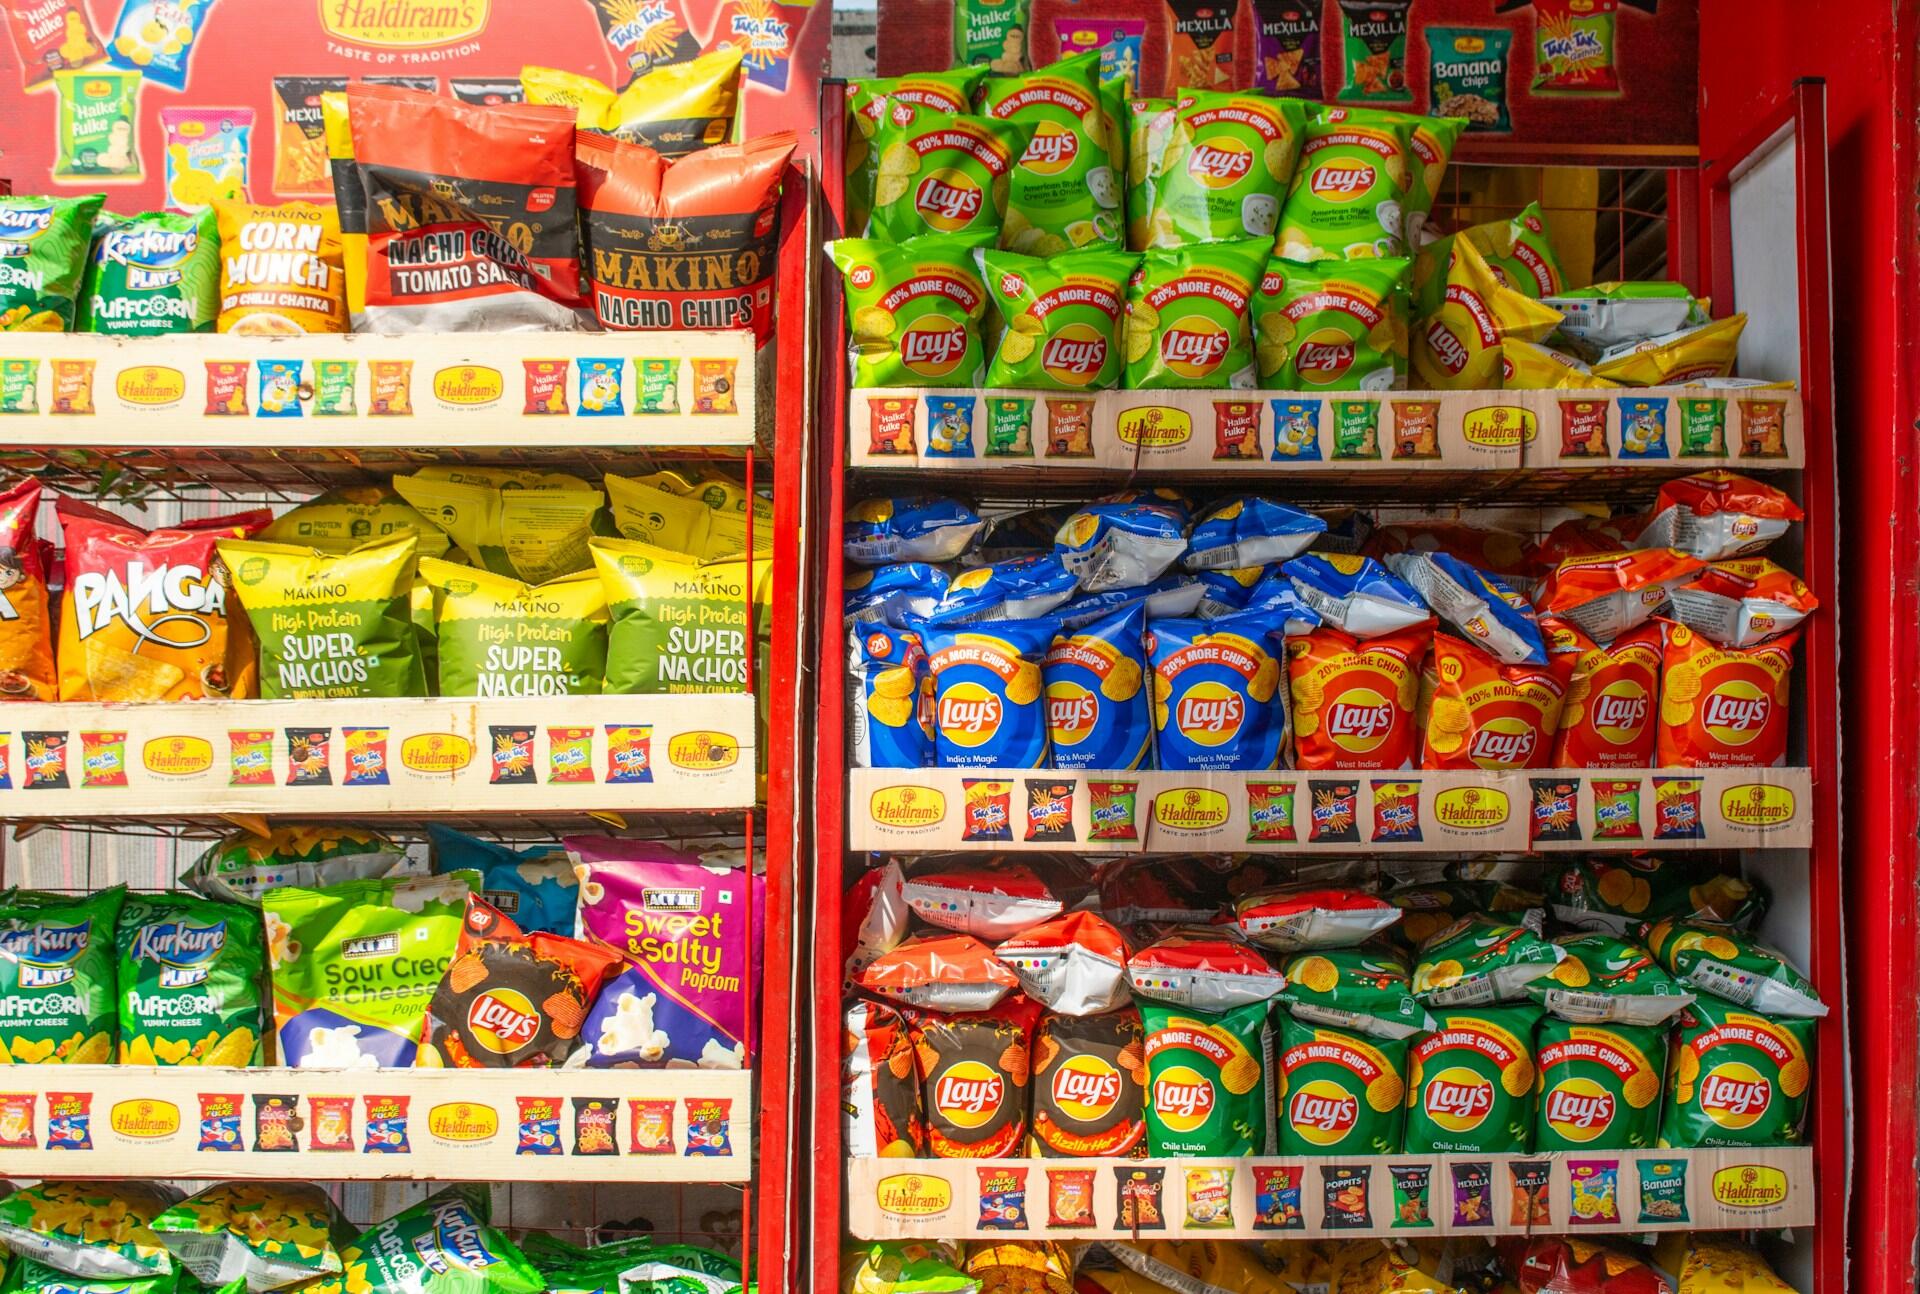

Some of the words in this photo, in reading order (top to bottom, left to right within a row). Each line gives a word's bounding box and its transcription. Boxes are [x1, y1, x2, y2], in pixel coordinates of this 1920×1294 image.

[25, 0, 66, 25] Halke
[334, 0, 476, 28] Haldiram's
[971, 5, 1011, 27] Halke
[27, 14, 64, 44] Fulke
[733, 16, 760, 32] TAKA
[764, 18, 789, 38] TAK
[966, 25, 1002, 43] Fulke
[1177, 19, 1233, 33] MEXILLA
[1263, 22, 1319, 35] MEXILLA
[1349, 21, 1405, 37] MEXILLA
[327, 42, 371, 62] TASTE
[377, 53, 396, 64] OF
[402, 42, 481, 64] TRADITION
[1543, 39, 1572, 59] TAKA
[1573, 31, 1598, 48] TAK
[1435, 60, 1502, 78] Banana
[75, 100, 117, 119] Halke
[72, 120, 109, 136] Fulke
[916, 137, 942, 153] 20%
[944, 134, 974, 149] MORE
[975, 142, 1002, 171] CHIPS
[1312, 166, 1374, 195] Lay's
[917, 178, 980, 219] Lay's
[250, 210, 323, 221] MAKINO
[101, 226, 198, 265] Kurkure
[240, 222, 322, 252] CORN
[388, 231, 465, 267] NACHO
[130, 270, 181, 288] PLAYZ
[226, 255, 328, 290] MUNCH
[397, 264, 472, 294] TOMATO
[593, 248, 761, 290] MAKINO
[240, 293, 277, 308] CHILLI
[279, 293, 329, 312] CHATKA
[885, 289, 909, 310] 20%
[909, 280, 943, 294] MORE
[944, 281, 976, 307] CHIPS
[91, 295, 198, 320] PUFFCORN
[598, 293, 672, 327] NACHO
[682, 295, 754, 328] CHIPS
[107, 320, 139, 329] YUMMY
[140, 320, 173, 329] CHEESE
[121, 378, 179, 398] Haldiram's
[439, 378, 497, 397] Haldiram's
[878, 421, 901, 432] Fulke
[881, 412, 906, 423] Halke
[993, 423, 1016, 433] Fulke
[997, 413, 1022, 423] Halke
[283, 584, 348, 601] MAKINO
[673, 581, 742, 597] MAKINO
[74, 561, 227, 647] PANGA
[493, 601, 560, 614] MAKINO
[272, 611, 306, 633] High
[308, 608, 362, 631] Protein
[658, 605, 697, 625] High
[478, 623, 513, 644] High
[516, 621, 572, 643] Protein
[666, 627, 744, 656] SUPER
[282, 633, 358, 661] SUPER
[485, 646, 562, 671] SUPER
[658, 655, 747, 683] NACHOS
[949, 649, 982, 662] MORE
[982, 651, 1011, 675] CHIPS
[1317, 662, 1341, 680] 20%
[1343, 656, 1374, 666] MORE
[1375, 658, 1405, 680] CHIPS
[1584, 652, 1609, 671] 20%
[278, 660, 368, 689] NACHOS
[477, 674, 568, 697] NACHOS
[941, 697, 998, 734] Lay's
[1182, 697, 1240, 734] Lay's
[1331, 704, 1391, 737] Lay's
[1596, 696, 1647, 729] Lay's
[1705, 698, 1766, 731] Lay's
[149, 751, 207, 768] Haldiram's
[406, 748, 465, 765] Haldiram's
[946, 755, 975, 764] India's
[976, 754, 998, 765] Magic
[1072, 752, 1096, 763] Magic
[1188, 754, 1215, 763] India's
[1216, 752, 1241, 763] Magic
[1336, 760, 1358, 768] West
[1359, 759, 1382, 768] Indies'
[1709, 752, 1729, 761] West
[1731, 753, 1756, 761] Indies'
[876, 802, 939, 819] Haldiram's
[1028, 806, 1047, 817] TAKA
[1048, 803, 1065, 814] TAK
[1160, 803, 1224, 821] Haldiram's
[1441, 803, 1503, 820] Haldiram's
[1727, 800, 1789, 818] Haldiram's
[624, 910, 723, 939] Sweet
[136, 922, 224, 963] Kurkure
[627, 937, 723, 974] &Salty
[22, 967, 74, 986] PLAYZ
[161, 967, 208, 985] PLAYZ
[324, 963, 383, 985] Sour
[680, 967, 740, 993] Popcorn
[129, 992, 224, 1016] PUFFCORN
[34, 1017, 69, 1026] CHEESE
[143, 1018, 169, 1027] YUMMY
[171, 1017, 202, 1026] CHEESE
[469, 997, 539, 1041] Lay's
[1697, 1032, 1719, 1050] 20%
[1720, 1027, 1754, 1041] MORE
[1755, 1033, 1788, 1059] CHIPS
[939, 1077, 1001, 1111] Lay's
[1057, 1072, 1117, 1105] Lay's
[1704, 1076, 1767, 1115] Lay's
[1428, 1081, 1488, 1118] Lay's
[1550, 1091, 1610, 1128] Lay's
[117, 1114, 175, 1130] Haldiram's
[1294, 1099, 1355, 1131] Lay's
[434, 1117, 492, 1135] Haldiram's
[1161, 1142, 1180, 1151] Chile
[1182, 1141, 1206, 1152] Limón
[1432, 1142, 1453, 1151] Chile
[1454, 1142, 1480, 1152] Limón
[986, 1176, 1018, 1185] HALKE
[986, 1184, 1017, 1192] FULKE
[1325, 1177, 1362, 1189] POPPITS
[1396, 1178, 1428, 1190] MEXILLA
[1457, 1178, 1490, 1188] MEXILLA
[1642, 1178, 1683, 1191] Banana
[883, 1189, 945, 1208] Haldiram's
[1718, 1183, 1782, 1200] Haldiram's
[882, 1213, 901, 1223] TASTE
[913, 1214, 946, 1224] TRADITION
[431, 1199, 489, 1269] Kurkure
[414, 1234, 448, 1274] PLAYZ
